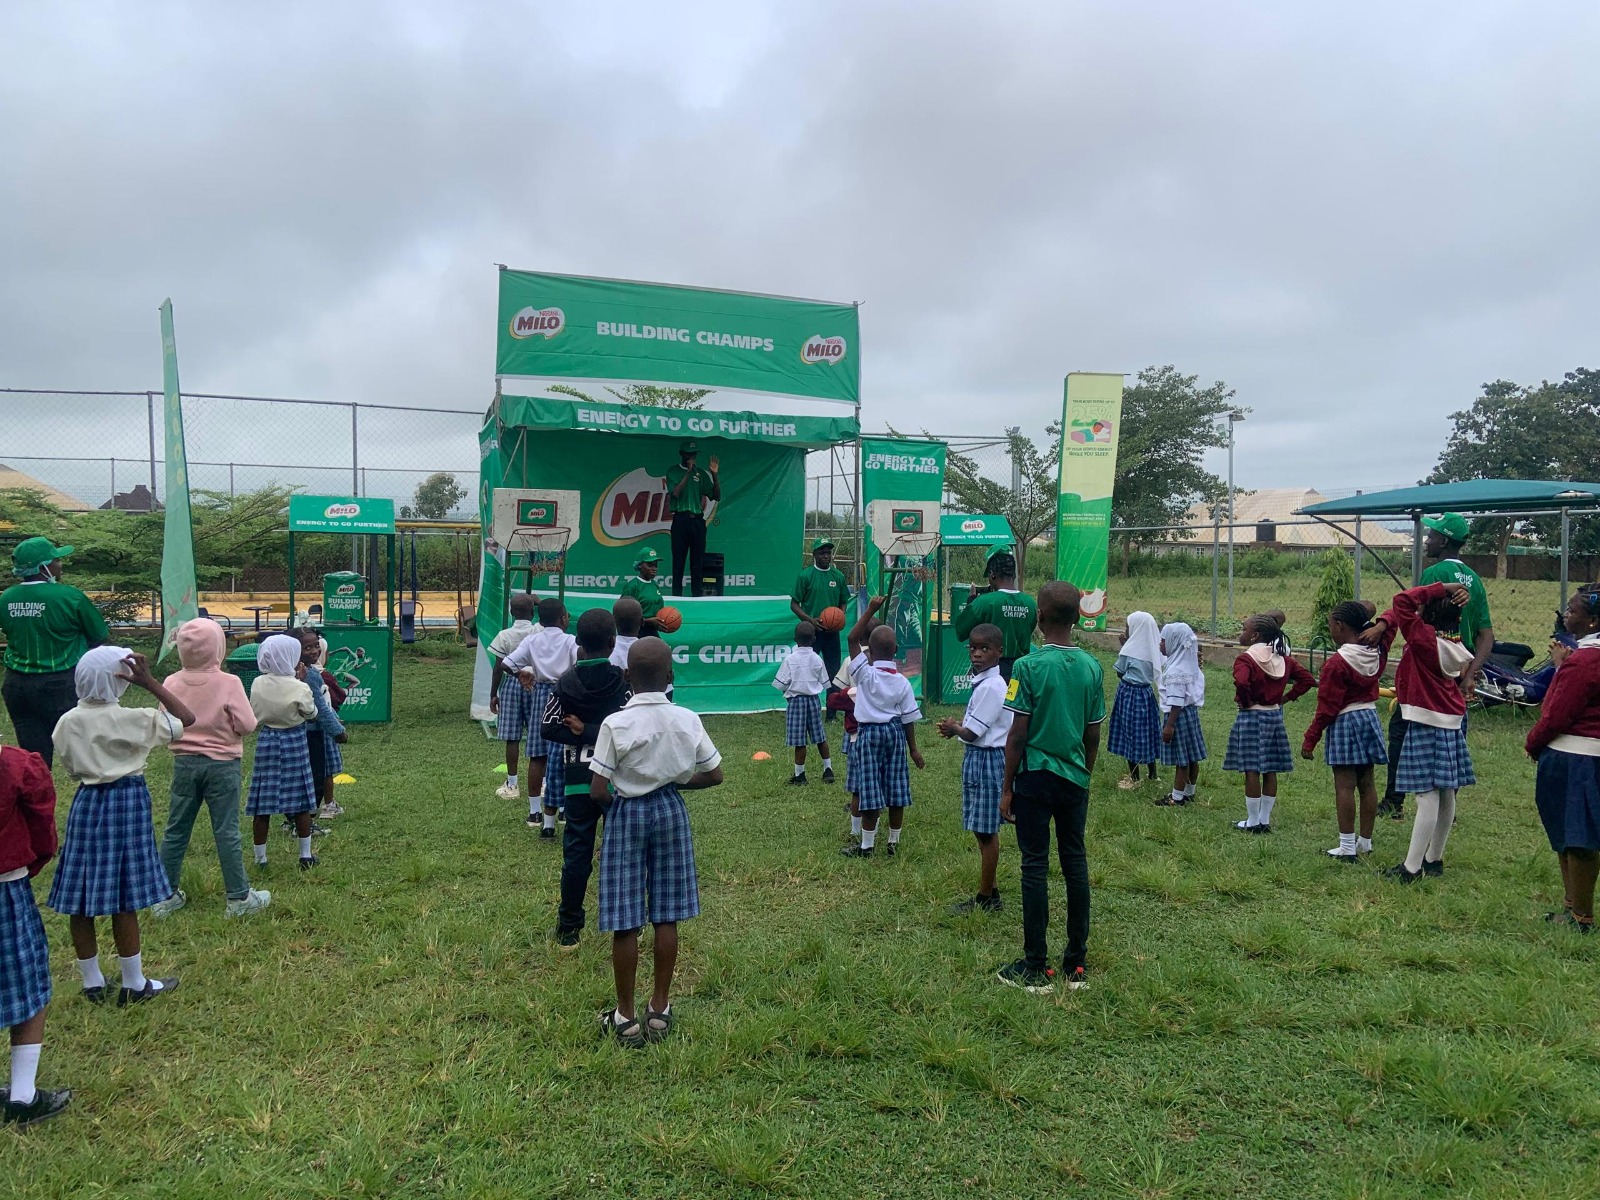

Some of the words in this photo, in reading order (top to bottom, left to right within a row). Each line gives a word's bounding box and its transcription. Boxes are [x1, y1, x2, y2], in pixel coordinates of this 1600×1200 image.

[517, 316, 560, 331] MILO
[596, 321, 690, 343] BUILDING
[696, 331, 775, 352] CHAMPS
[807, 343, 843, 357] MILO
[577, 408, 651, 428] ENERGY
[656, 415, 682, 431] TO
[687, 417, 714, 432] GO
[720, 419, 797, 437] FURTHER
[869, 453, 916, 464] ENERGY
[919, 457, 936, 466] TO
[865, 460, 880, 470] GO
[884, 461, 940, 475] FURTHER
[329, 507, 357, 515] MILO
[610, 491, 707, 527] MIL
[549, 575, 620, 587] ENERGY
[7, 602, 46, 611] BUILDING
[9, 610, 42, 618] CHAMPS
[698, 645, 798, 664] CHAMP
